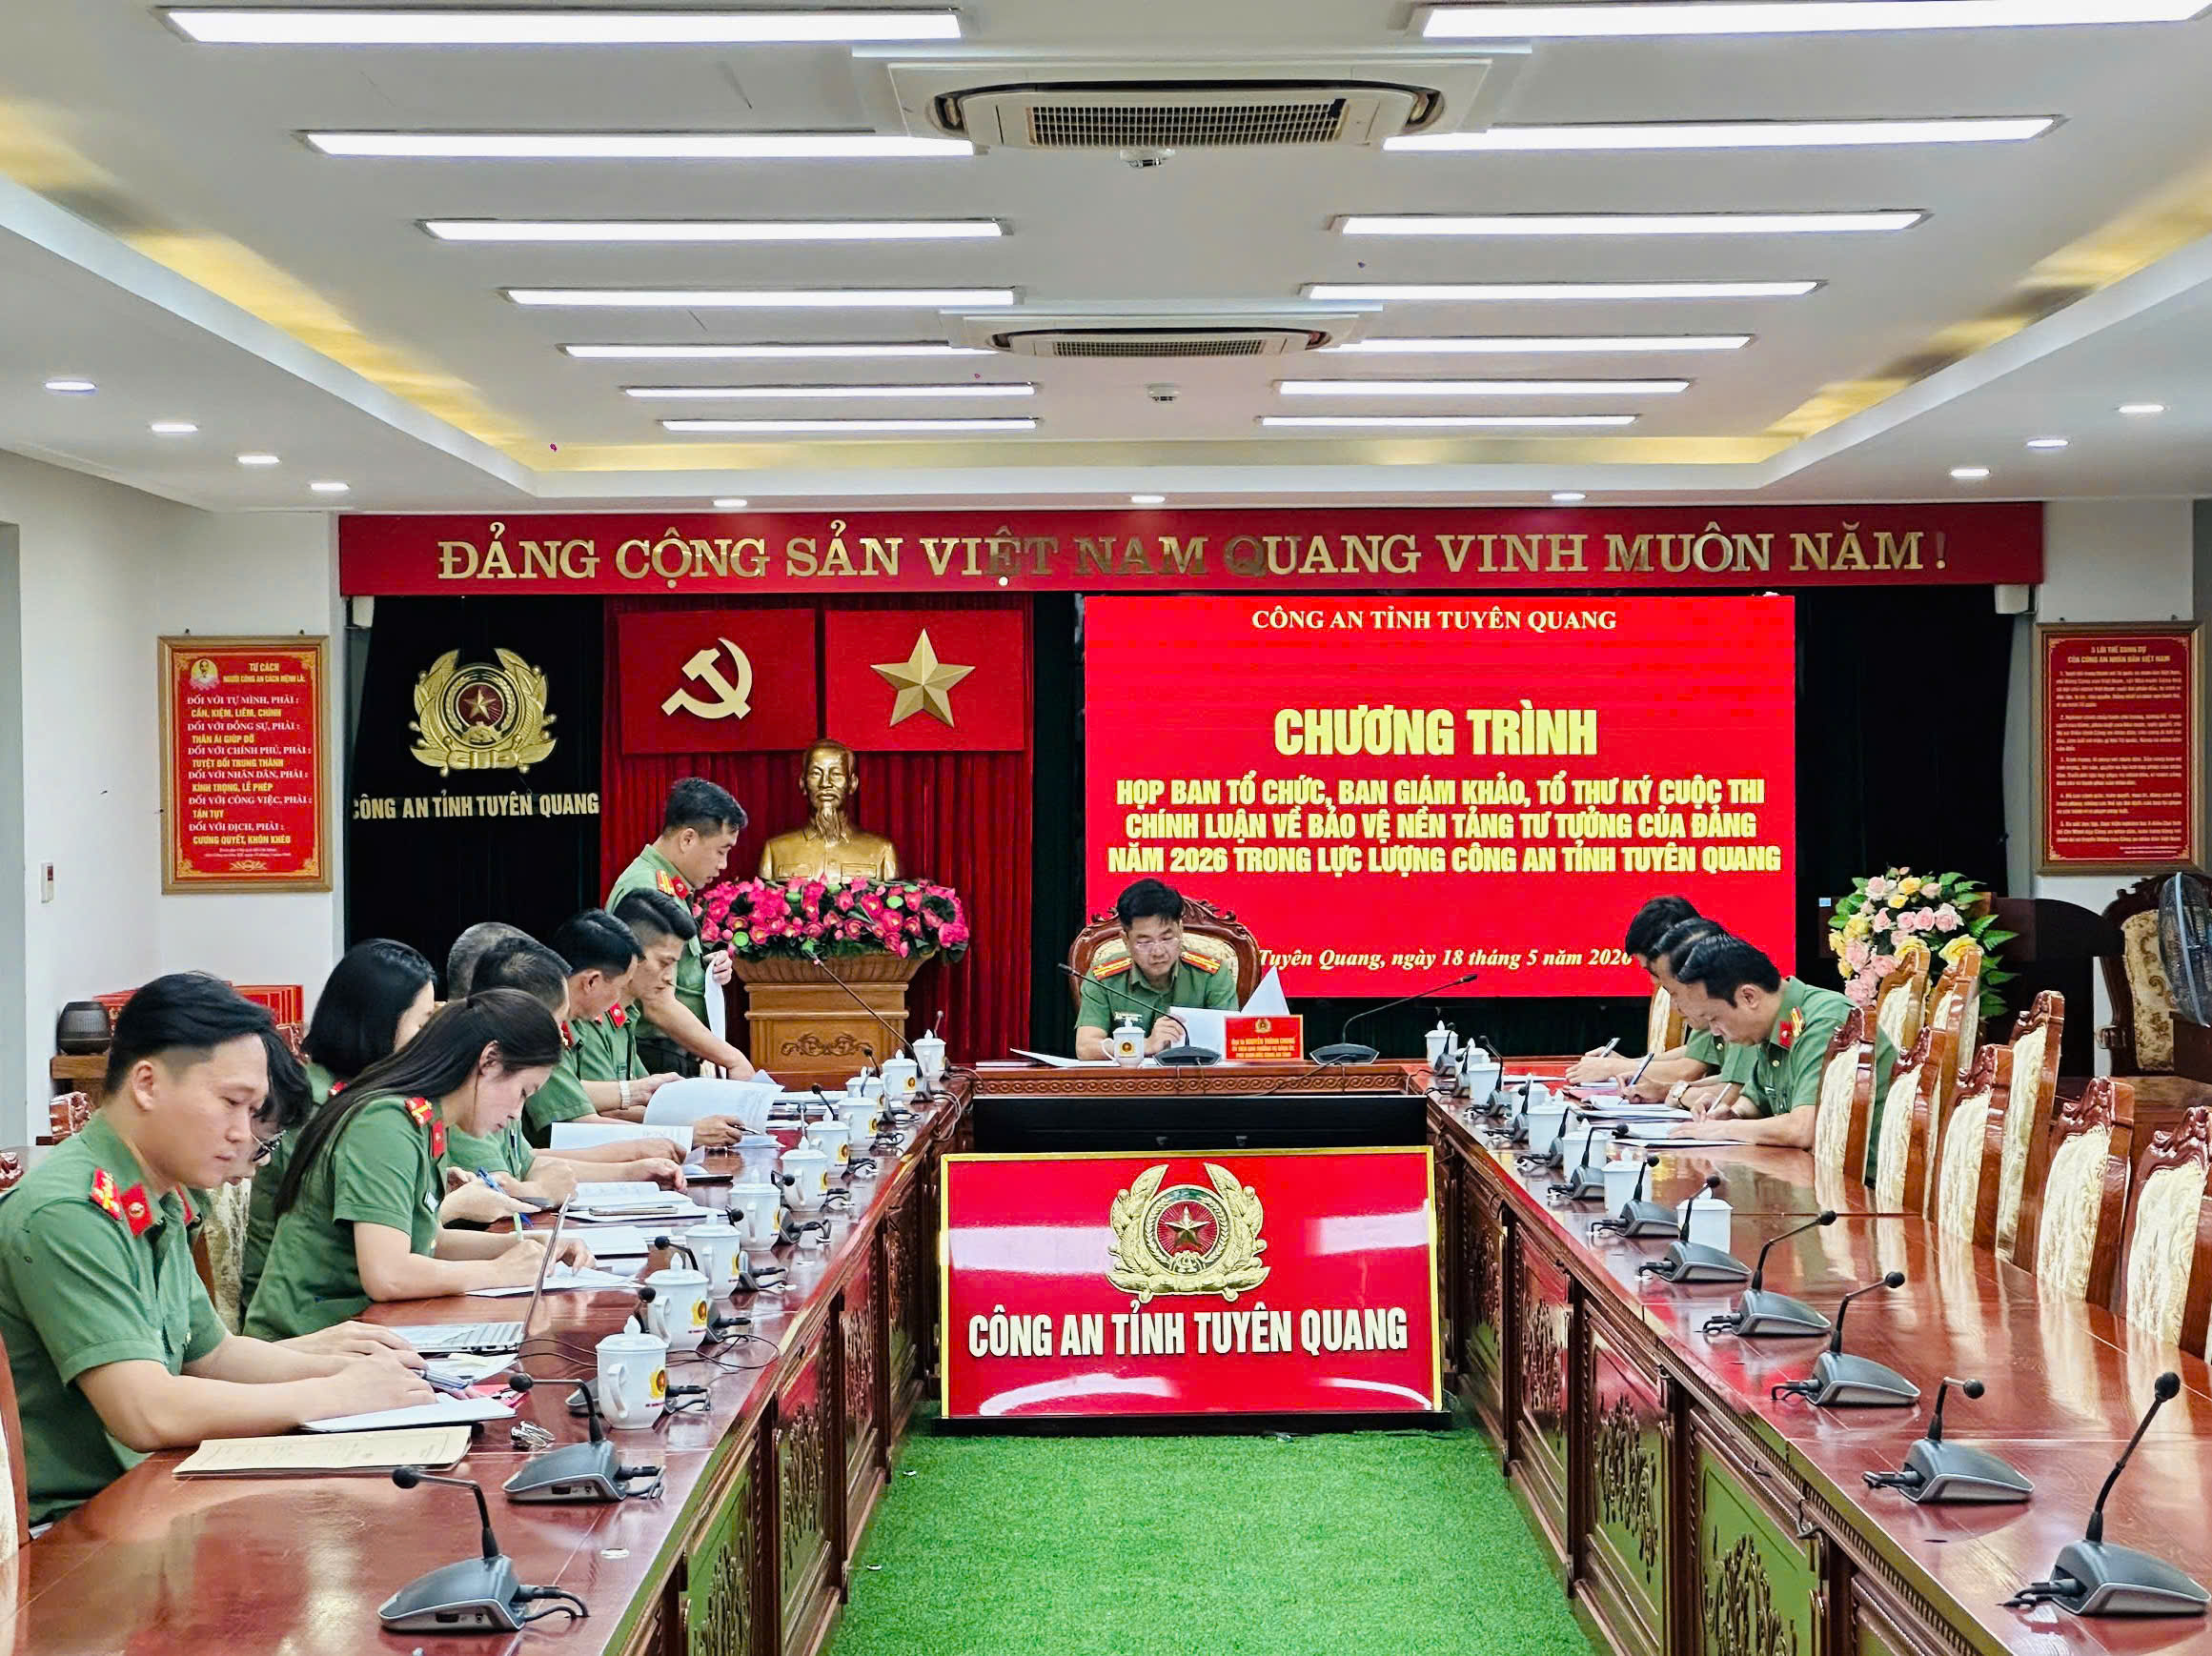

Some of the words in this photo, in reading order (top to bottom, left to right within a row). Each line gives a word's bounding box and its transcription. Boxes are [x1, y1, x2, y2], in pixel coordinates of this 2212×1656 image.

[436, 521, 601, 579] ĐẢNG
[615, 526, 771, 589] CỘNG
[785, 519, 903, 577] SẢN
[919, 525, 1060, 587] VIỆT
[1072, 536, 1209, 576] NAM
[1224, 534, 1422, 577] QUANG
[1435, 534, 1590, 574] VINH
[1604, 521, 1775, 573] MUÔN
[1251, 605, 1324, 630] CÔNG
[1329, 610, 1364, 630] AN
[1370, 605, 1431, 630] TỈNH
[1437, 605, 1522, 630] TUYÊN
[1527, 610, 1617, 634] QUANG
[187, 694, 205, 704] ĐỐI
[207, 695, 225, 704] VỚI
[226, 696, 239, 706] TỰ
[187, 720, 205, 731] ĐỐI
[207, 721, 224, 731] VỚI
[227, 719, 254, 731] ĐỒNG
[1274, 703, 1455, 757] CHƯƠNG
[1466, 698, 1598, 757] TRÌNH
[188, 744, 206, 755] ĐỐI
[207, 745, 225, 755] VỚI
[227, 745, 257, 755] CHÍNH
[188, 769, 206, 779] ĐỐI
[207, 770, 225, 778] VỚI
[227, 769, 255, 778] NHÂN
[188, 794, 206, 805] ĐỐI
[208, 795, 226, 804] VỚI
[227, 794, 254, 804] CÔNG
[401, 798, 429, 819] AN
[432, 789, 473, 818] TỈNH
[476, 790, 534, 818] TUYÊN
[538, 792, 600, 818] QUANG
[1116, 779, 1166, 810] HỌP
[1170, 779, 1221, 805] BAN
[1226, 770, 1257, 805] TỔ
[1262, 774, 1333, 808] CHỨC,
[1338, 779, 1389, 805] BAN
[1394, 775, 1455, 805] GIÁM
[1461, 771, 1532, 808] KHẢO,
[1536, 770, 1568, 805] TỔ
[1572, 778, 1620, 805] THƯ
[1621, 774, 1654, 805] KÝ
[1658, 774, 1723, 810] CUỘC
[1727, 778, 1765, 804] THI
[188, 820, 207, 831] ĐỐI
[208, 821, 226, 831] VỚI
[1126, 808, 1199, 838] CHÍNH
[1205, 808, 1267, 843] LUẬN
[1272, 806, 1303, 838] VỀ
[1308, 804, 1357, 838] BẢO
[1361, 809, 1391, 843] VỆ
[1396, 806, 1447, 838] NỀN
[1451, 805, 1514, 839] TẢNG
[1519, 810, 1552, 838] TƯ
[1553, 805, 1633, 838] TƯỞNG
[1637, 805, 1686, 838] CỦA
[1691, 805, 1757, 838] ĐẢNG
[1107, 841, 1165, 873] NĂM
[1169, 847, 1229, 873] 2026
[1233, 847, 1312, 873] TRONG
[1317, 844, 1364, 878] LỰC
[1368, 844, 1447, 878] LƯỢNG
[1451, 841, 1517, 873] CÔNG
[1521, 847, 1556, 873] AN
[1561, 838, 1616, 873] TỈNH
[1620, 841, 1696, 873] TUYÊN
[1701, 845, 1782, 875] QUANG
[1259, 948, 1312, 970] Tuyên
[1318, 949, 1386, 971] Quang,
[1391, 950, 1436, 971] ngày
[1442, 949, 1464, 966] 18
[1468, 949, 1522, 971] tháng
[1527, 949, 1538, 966] 5
[1543, 950, 1582, 966] năm
[967, 1304, 1052, 1358] CÔNG
[1060, 1313, 1106, 1357] AN
[1111, 1301, 1185, 1356] TỈNH
[1193, 1302, 1293, 1355] TUYÊN
[1300, 1307, 1408, 1356] QUANG
